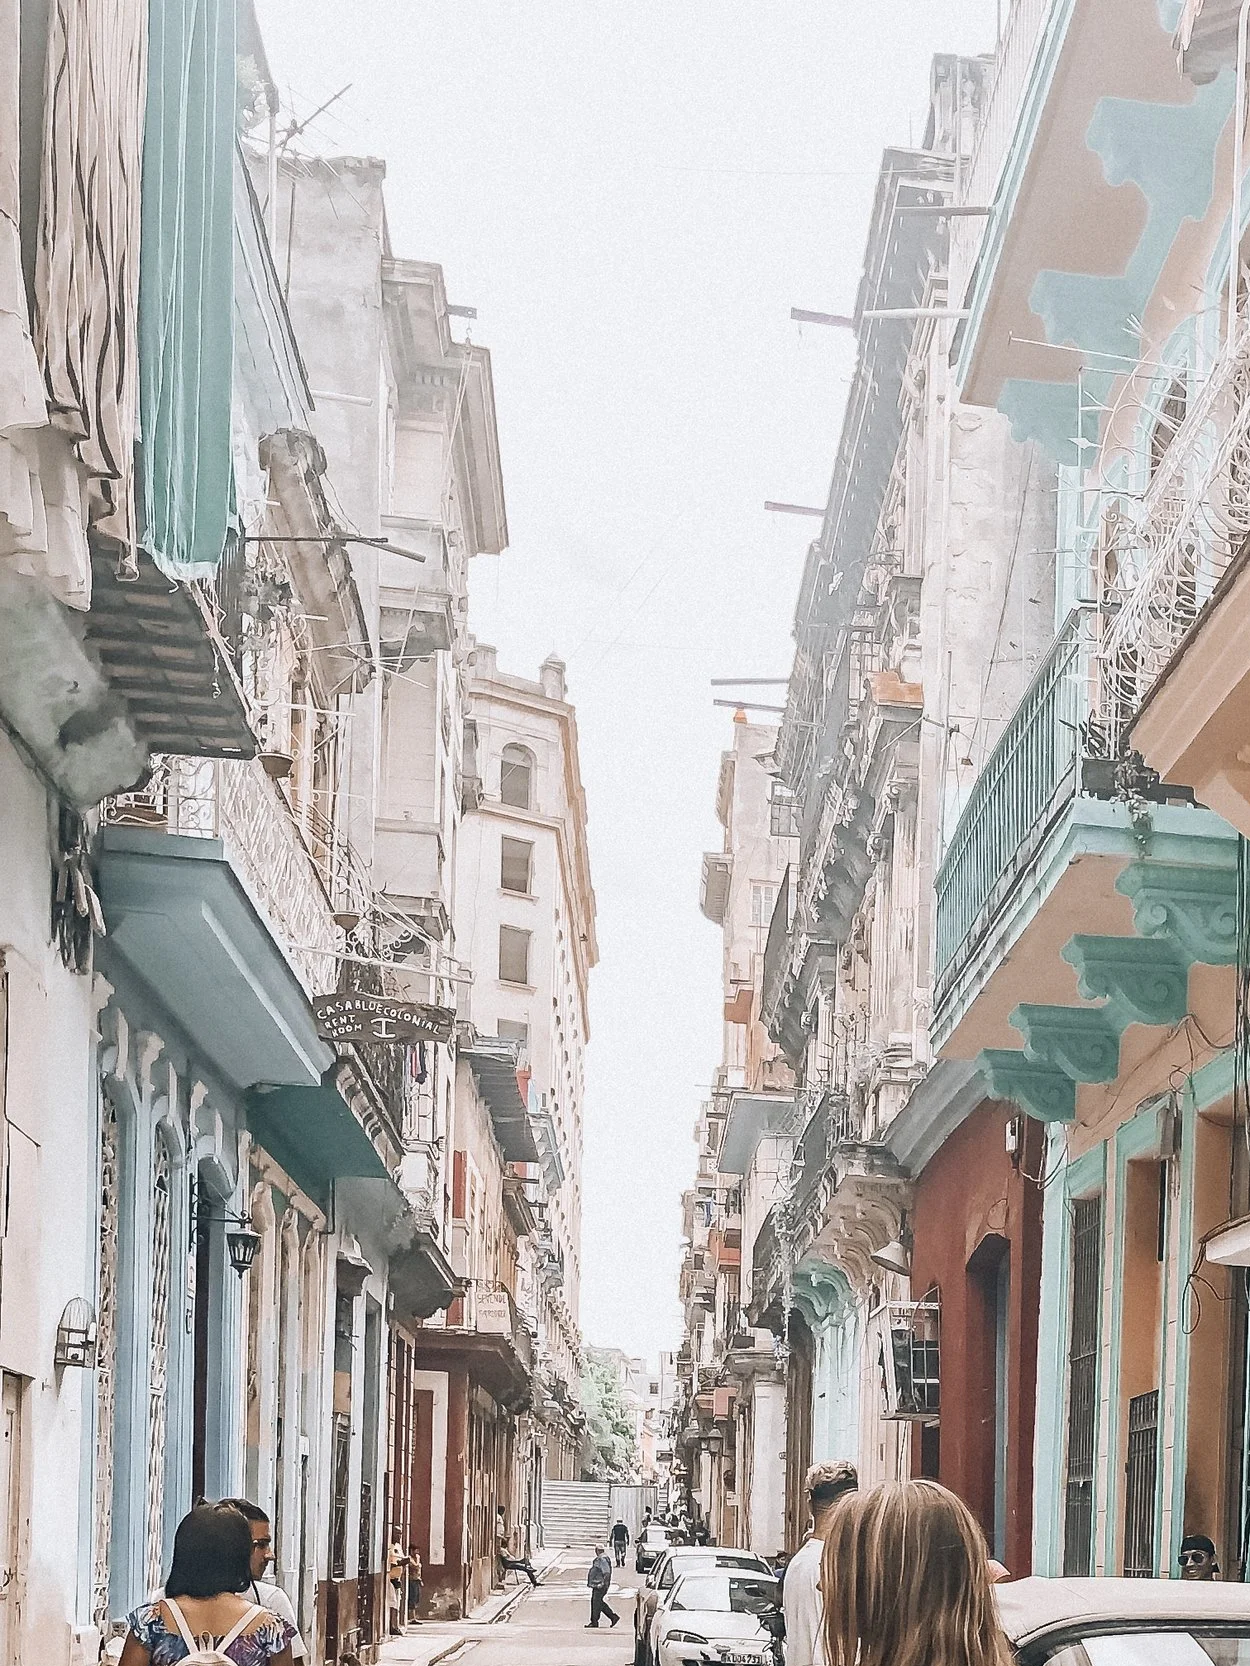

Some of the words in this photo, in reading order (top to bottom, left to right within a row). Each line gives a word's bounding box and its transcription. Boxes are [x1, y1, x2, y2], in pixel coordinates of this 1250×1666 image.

[317, 1000, 353, 1020] CASA
[383, 1007, 440, 1035] COLONIAL
[324, 1014, 356, 1029] RENT
